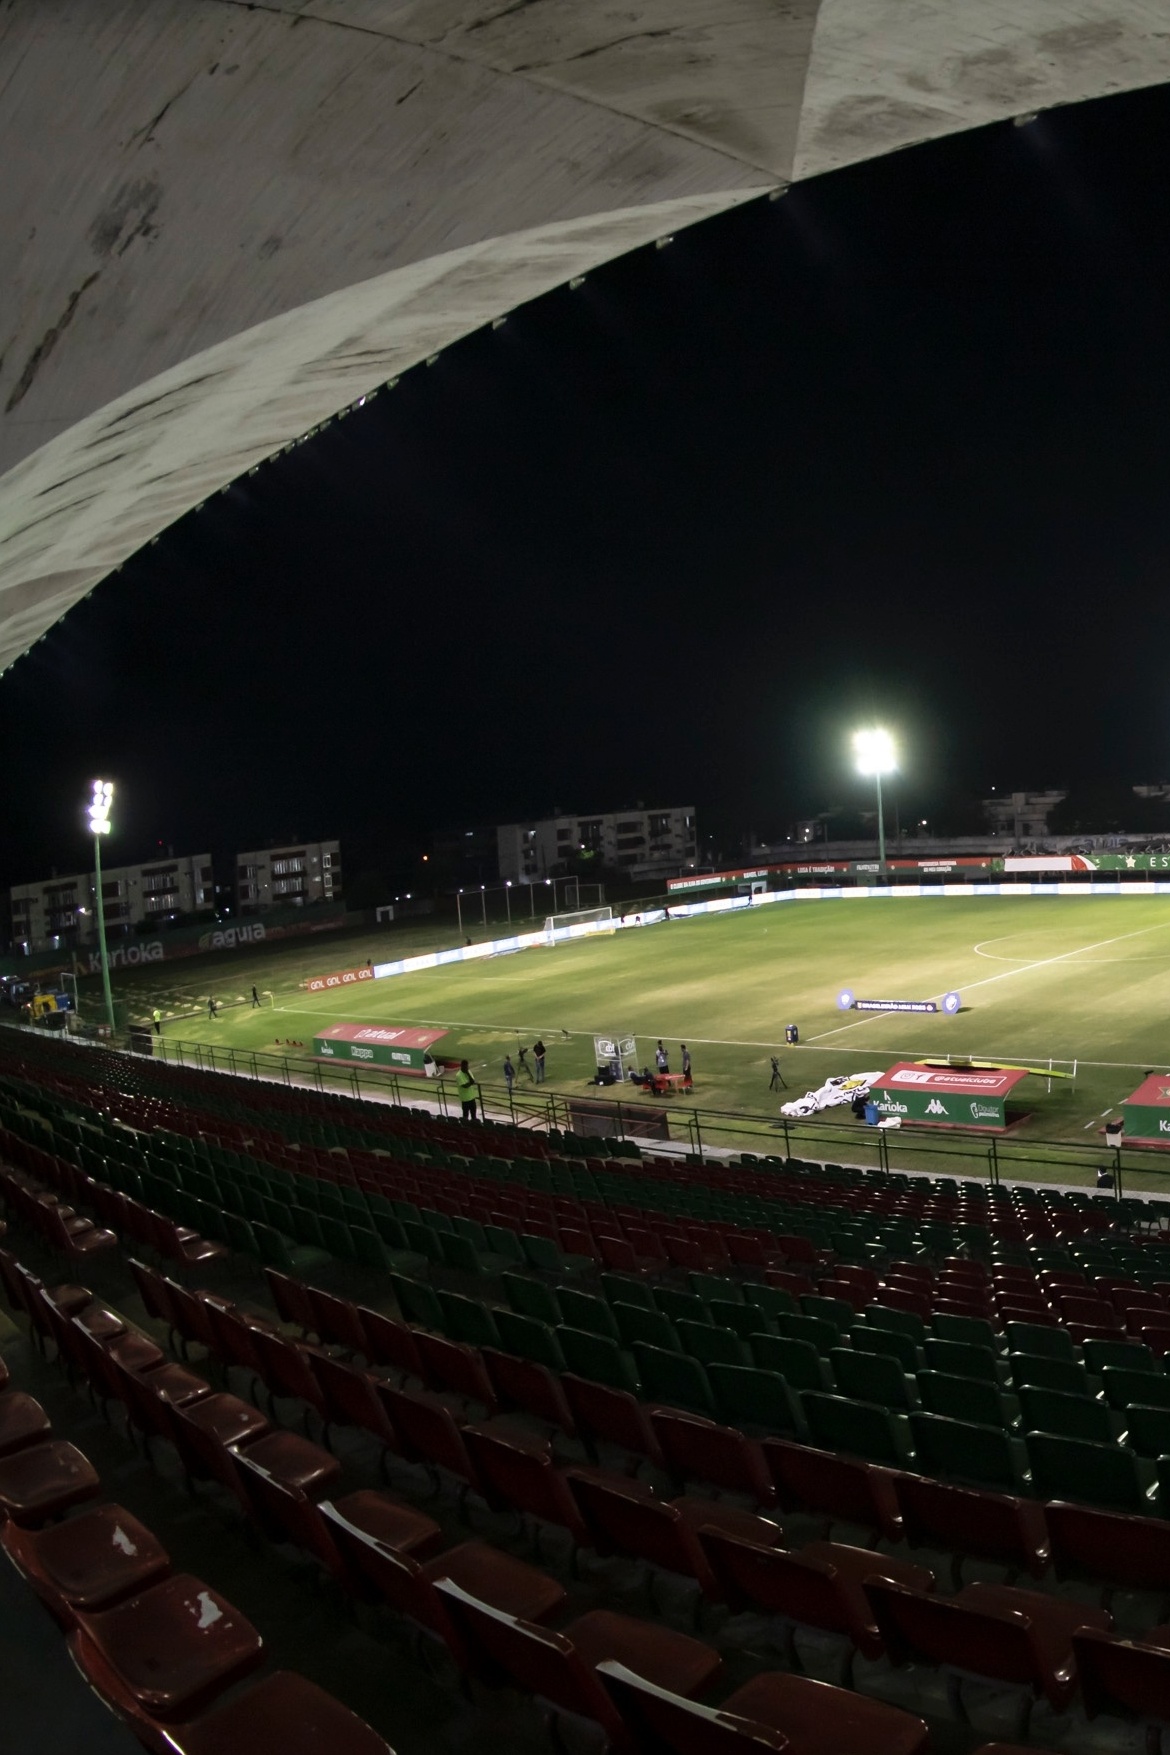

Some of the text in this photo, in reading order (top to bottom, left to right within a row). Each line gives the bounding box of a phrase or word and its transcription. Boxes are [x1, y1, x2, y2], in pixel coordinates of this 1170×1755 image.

[310, 969, 372, 990] GOL GOL GOL GOL
[351, 1046, 374, 1059] Kappa
[934, 1075, 996, 1085] @atualclube
